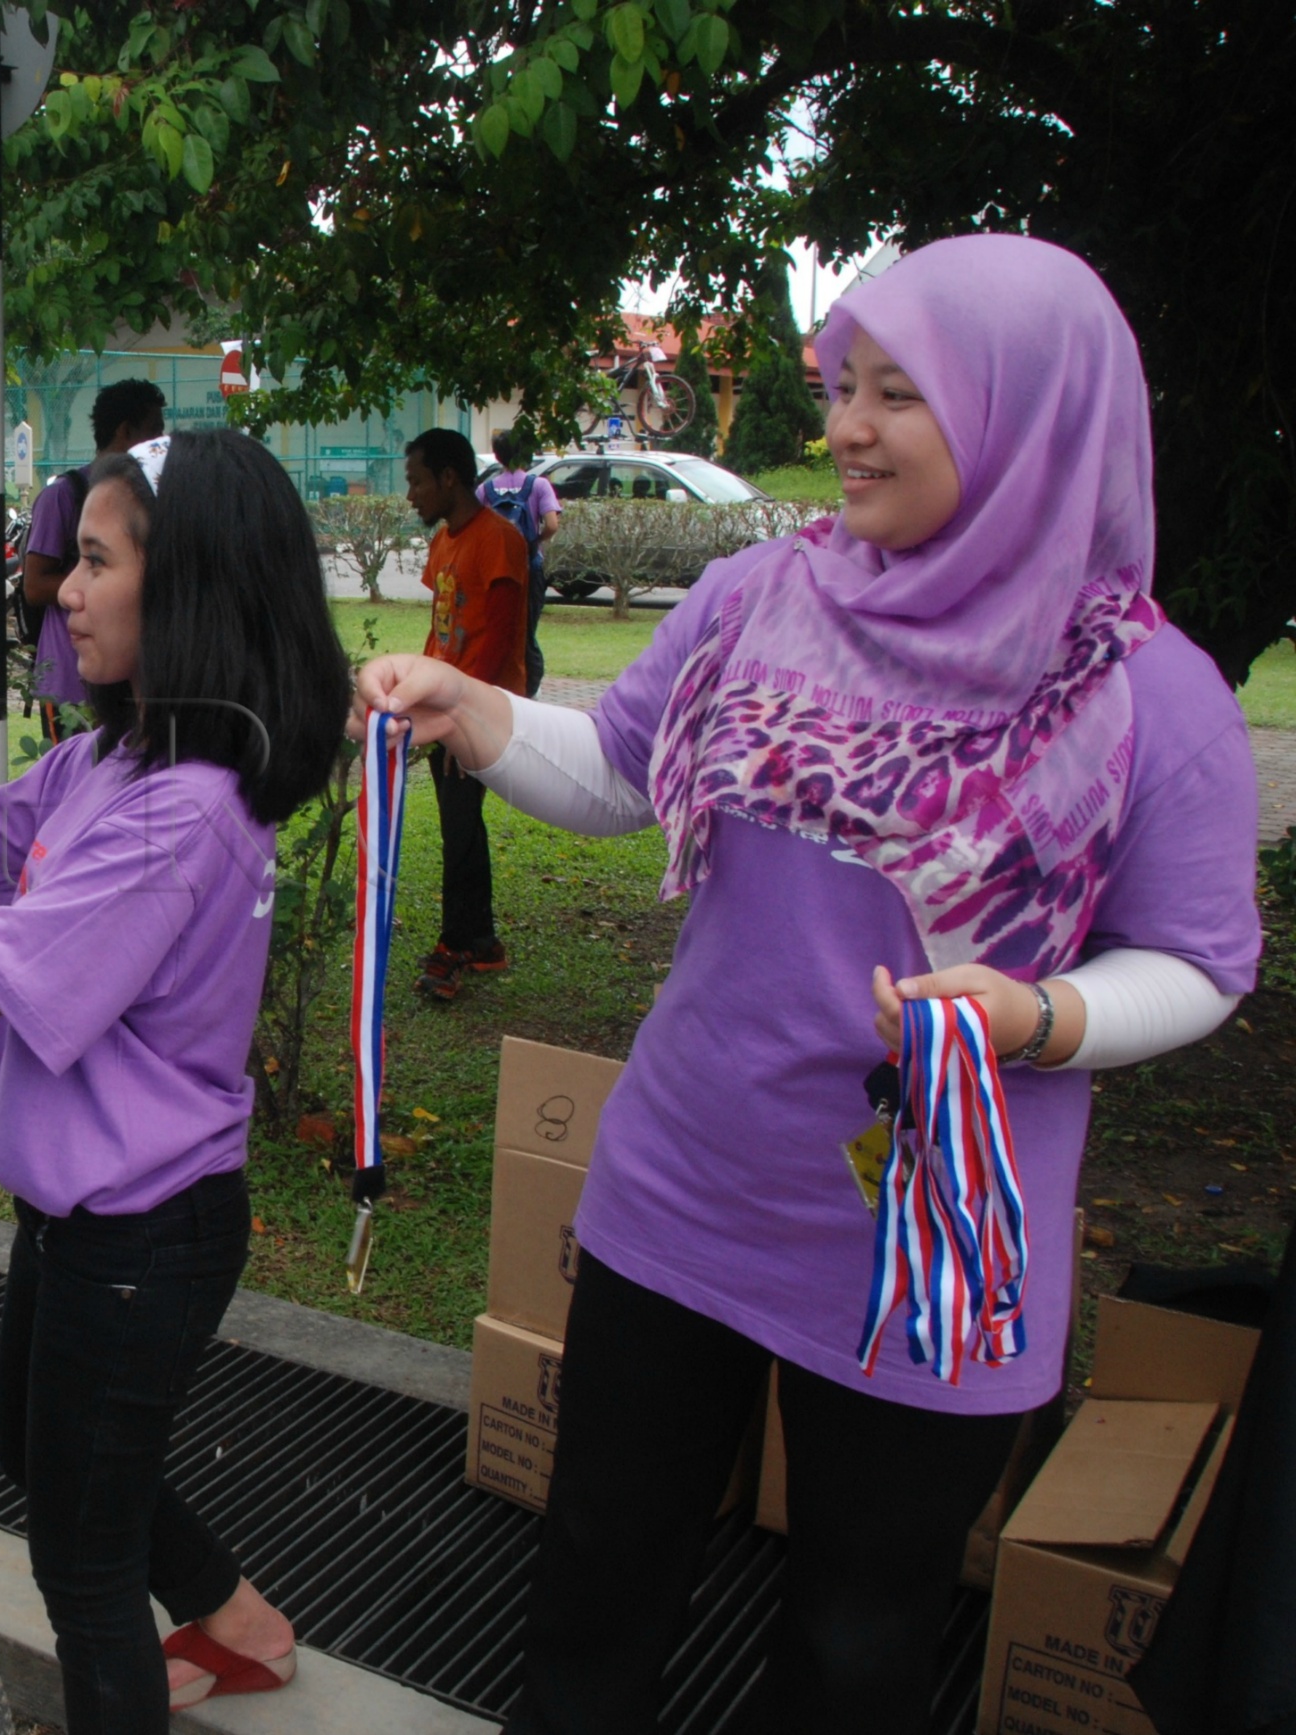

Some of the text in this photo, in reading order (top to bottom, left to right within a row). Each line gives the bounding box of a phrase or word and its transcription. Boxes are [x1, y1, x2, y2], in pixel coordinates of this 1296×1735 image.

[773, 667, 806, 693] LOUIS
[812, 684, 873, 720] VUITTON
[880, 700, 935, 723] LOUIS
[501, 1396, 551, 1428] MADE IN
[483, 1415, 523, 1442] CARTON
[525, 1433, 540, 1448] NO
[482, 1440, 516, 1464] MODEL
[517, 1457, 533, 1472] NO
[480, 1464, 527, 1494] QUANTITY
[1045, 1634, 1124, 1674] MADE IN
[1012, 1656, 1076, 1688] CARTON
[1079, 1680, 1103, 1699] NO
[1007, 1686, 1062, 1717] MODEL
[1066, 1706, 1090, 1725] NO
